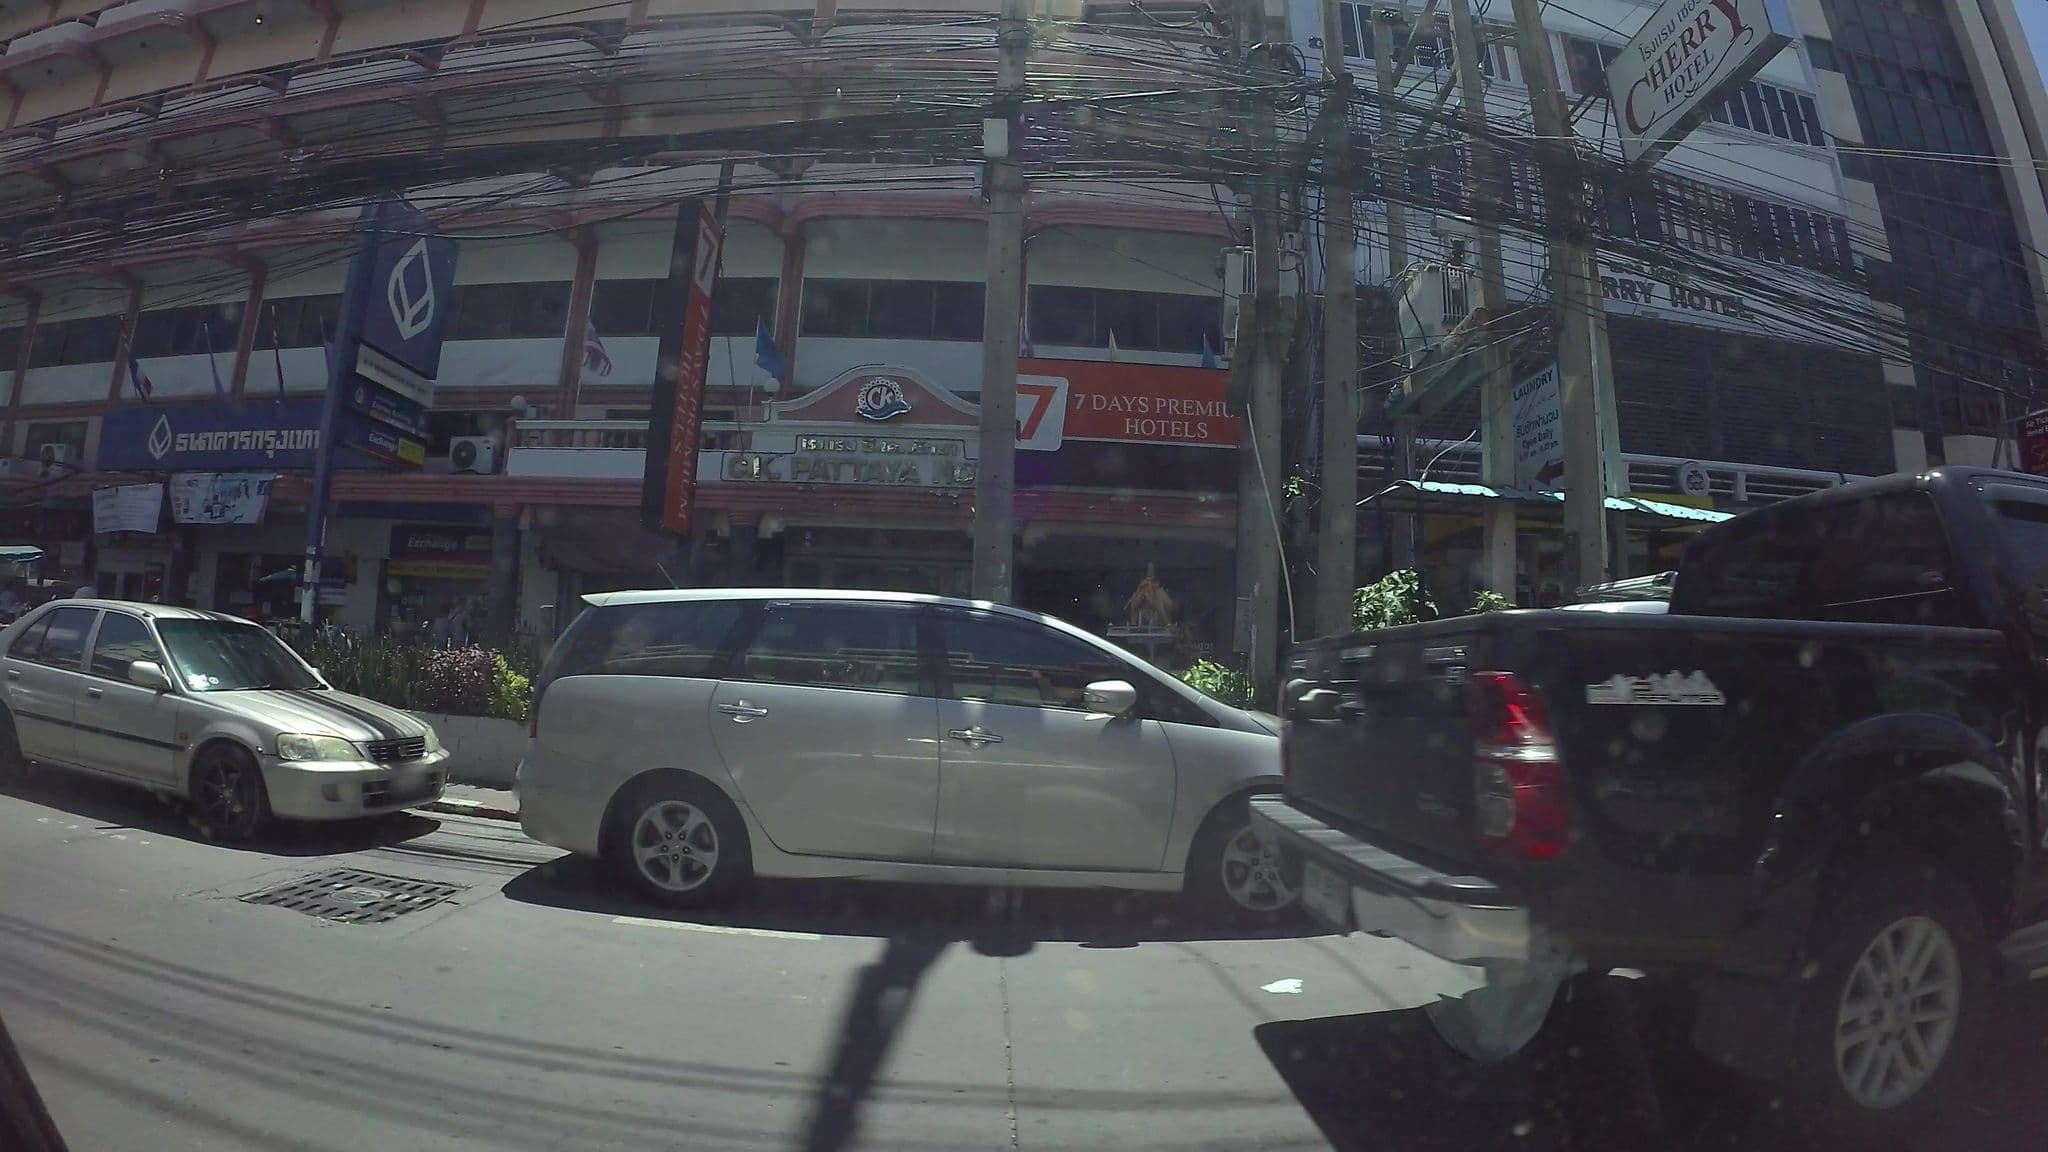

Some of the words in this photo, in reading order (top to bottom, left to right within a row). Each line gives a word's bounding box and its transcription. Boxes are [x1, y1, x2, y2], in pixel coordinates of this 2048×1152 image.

[1626, 0, 1750, 135] CHERRY
[1663, 48, 1715, 104] HOTEL
[1670, 285, 1754, 319] HOTEL
[674, 351, 692, 455] HOTELS
[1074, 393, 1086, 410] 7
[1092, 394, 1149, 414] DAYS
[1513, 369, 1553, 402] LAUNDRY
[1017, 383, 1058, 440] 7
[1124, 418, 1209, 440] HOTELS
[677, 397, 697, 521] PREMIUM
[789, 456, 921, 483] PATTAYA
